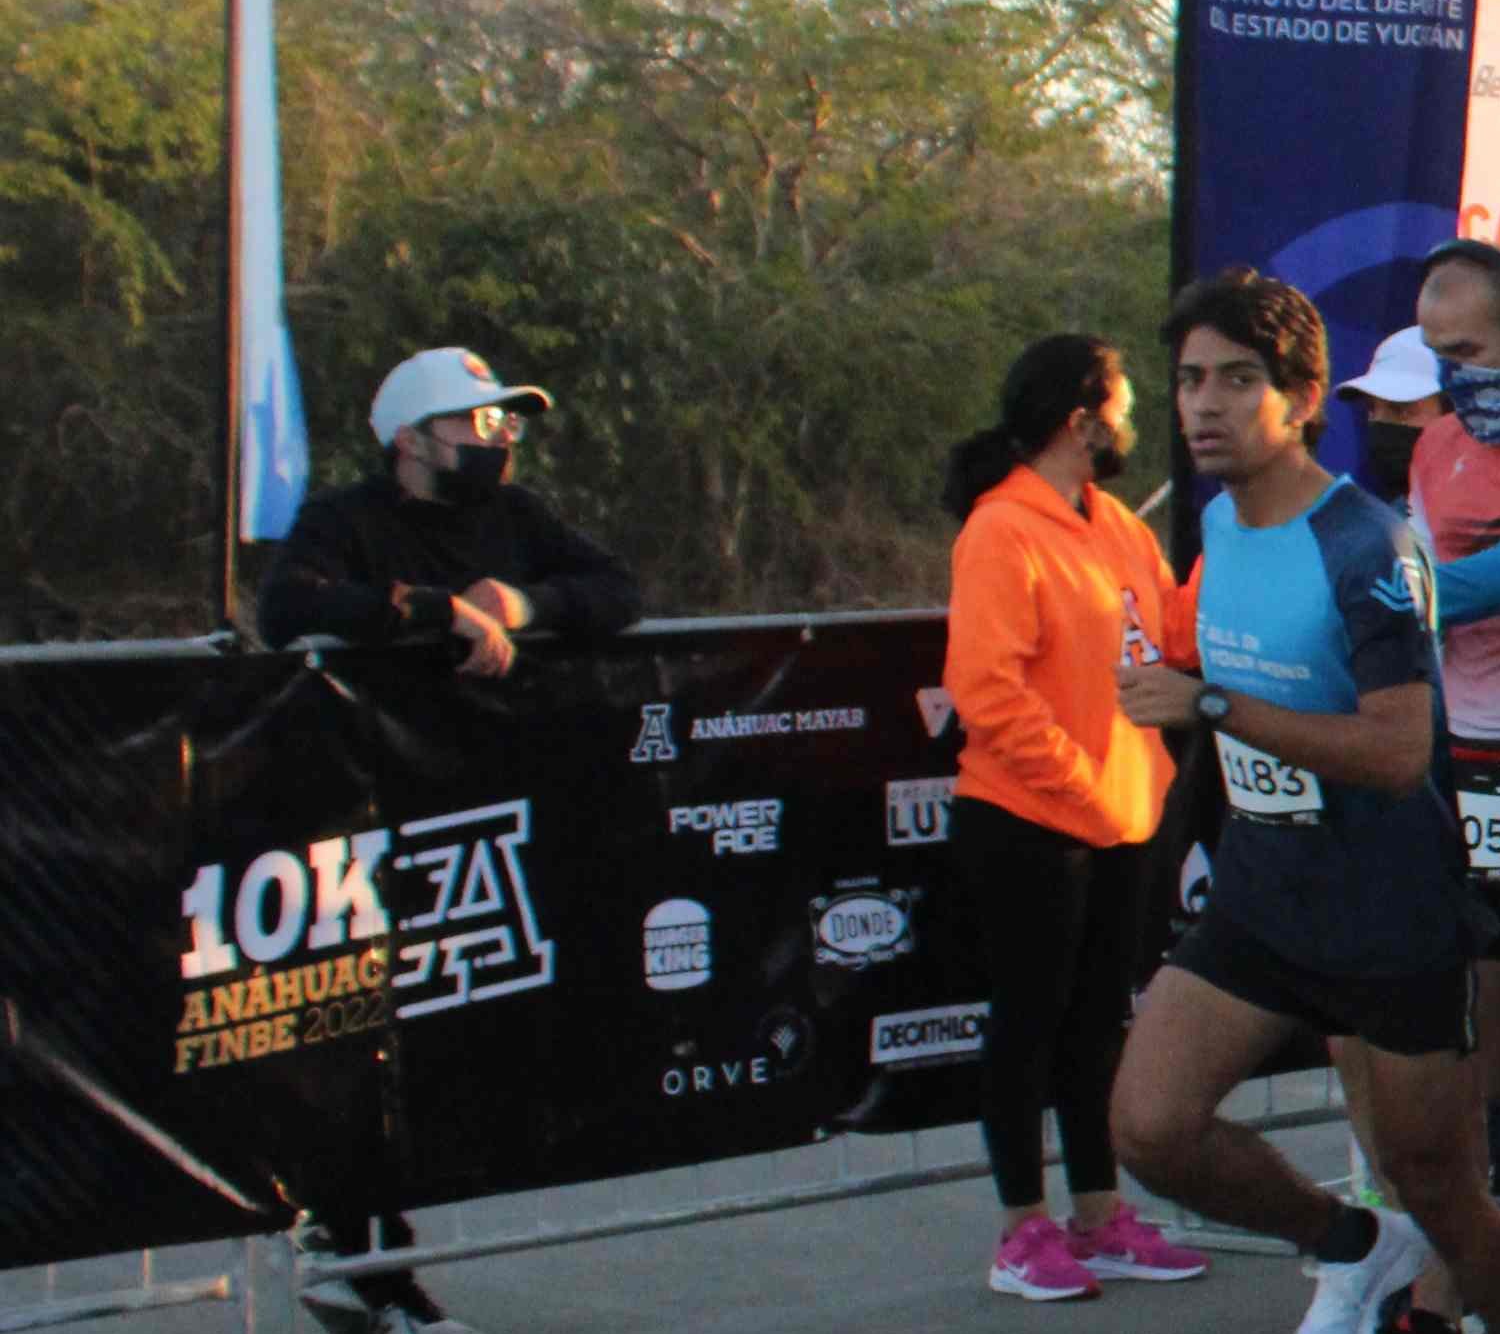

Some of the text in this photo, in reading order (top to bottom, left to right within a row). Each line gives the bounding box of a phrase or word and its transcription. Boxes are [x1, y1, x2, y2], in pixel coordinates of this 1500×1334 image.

[1233, 11, 1331, 43] ESTADO
[1336, 20, 1370, 44] DE
[1376, 21, 1465, 51] YUCÁN
[689, 707, 866, 740] ANÁHUAC MAYAB
[669, 798, 783, 834] POWER
[712, 825, 778, 855] ADE
[180, 827, 392, 981] 10K
[176, 946, 389, 1034] ANÁHUAC
[173, 992, 389, 1075] FINBE 2022
[662, 1056, 769, 1096] ORVE
